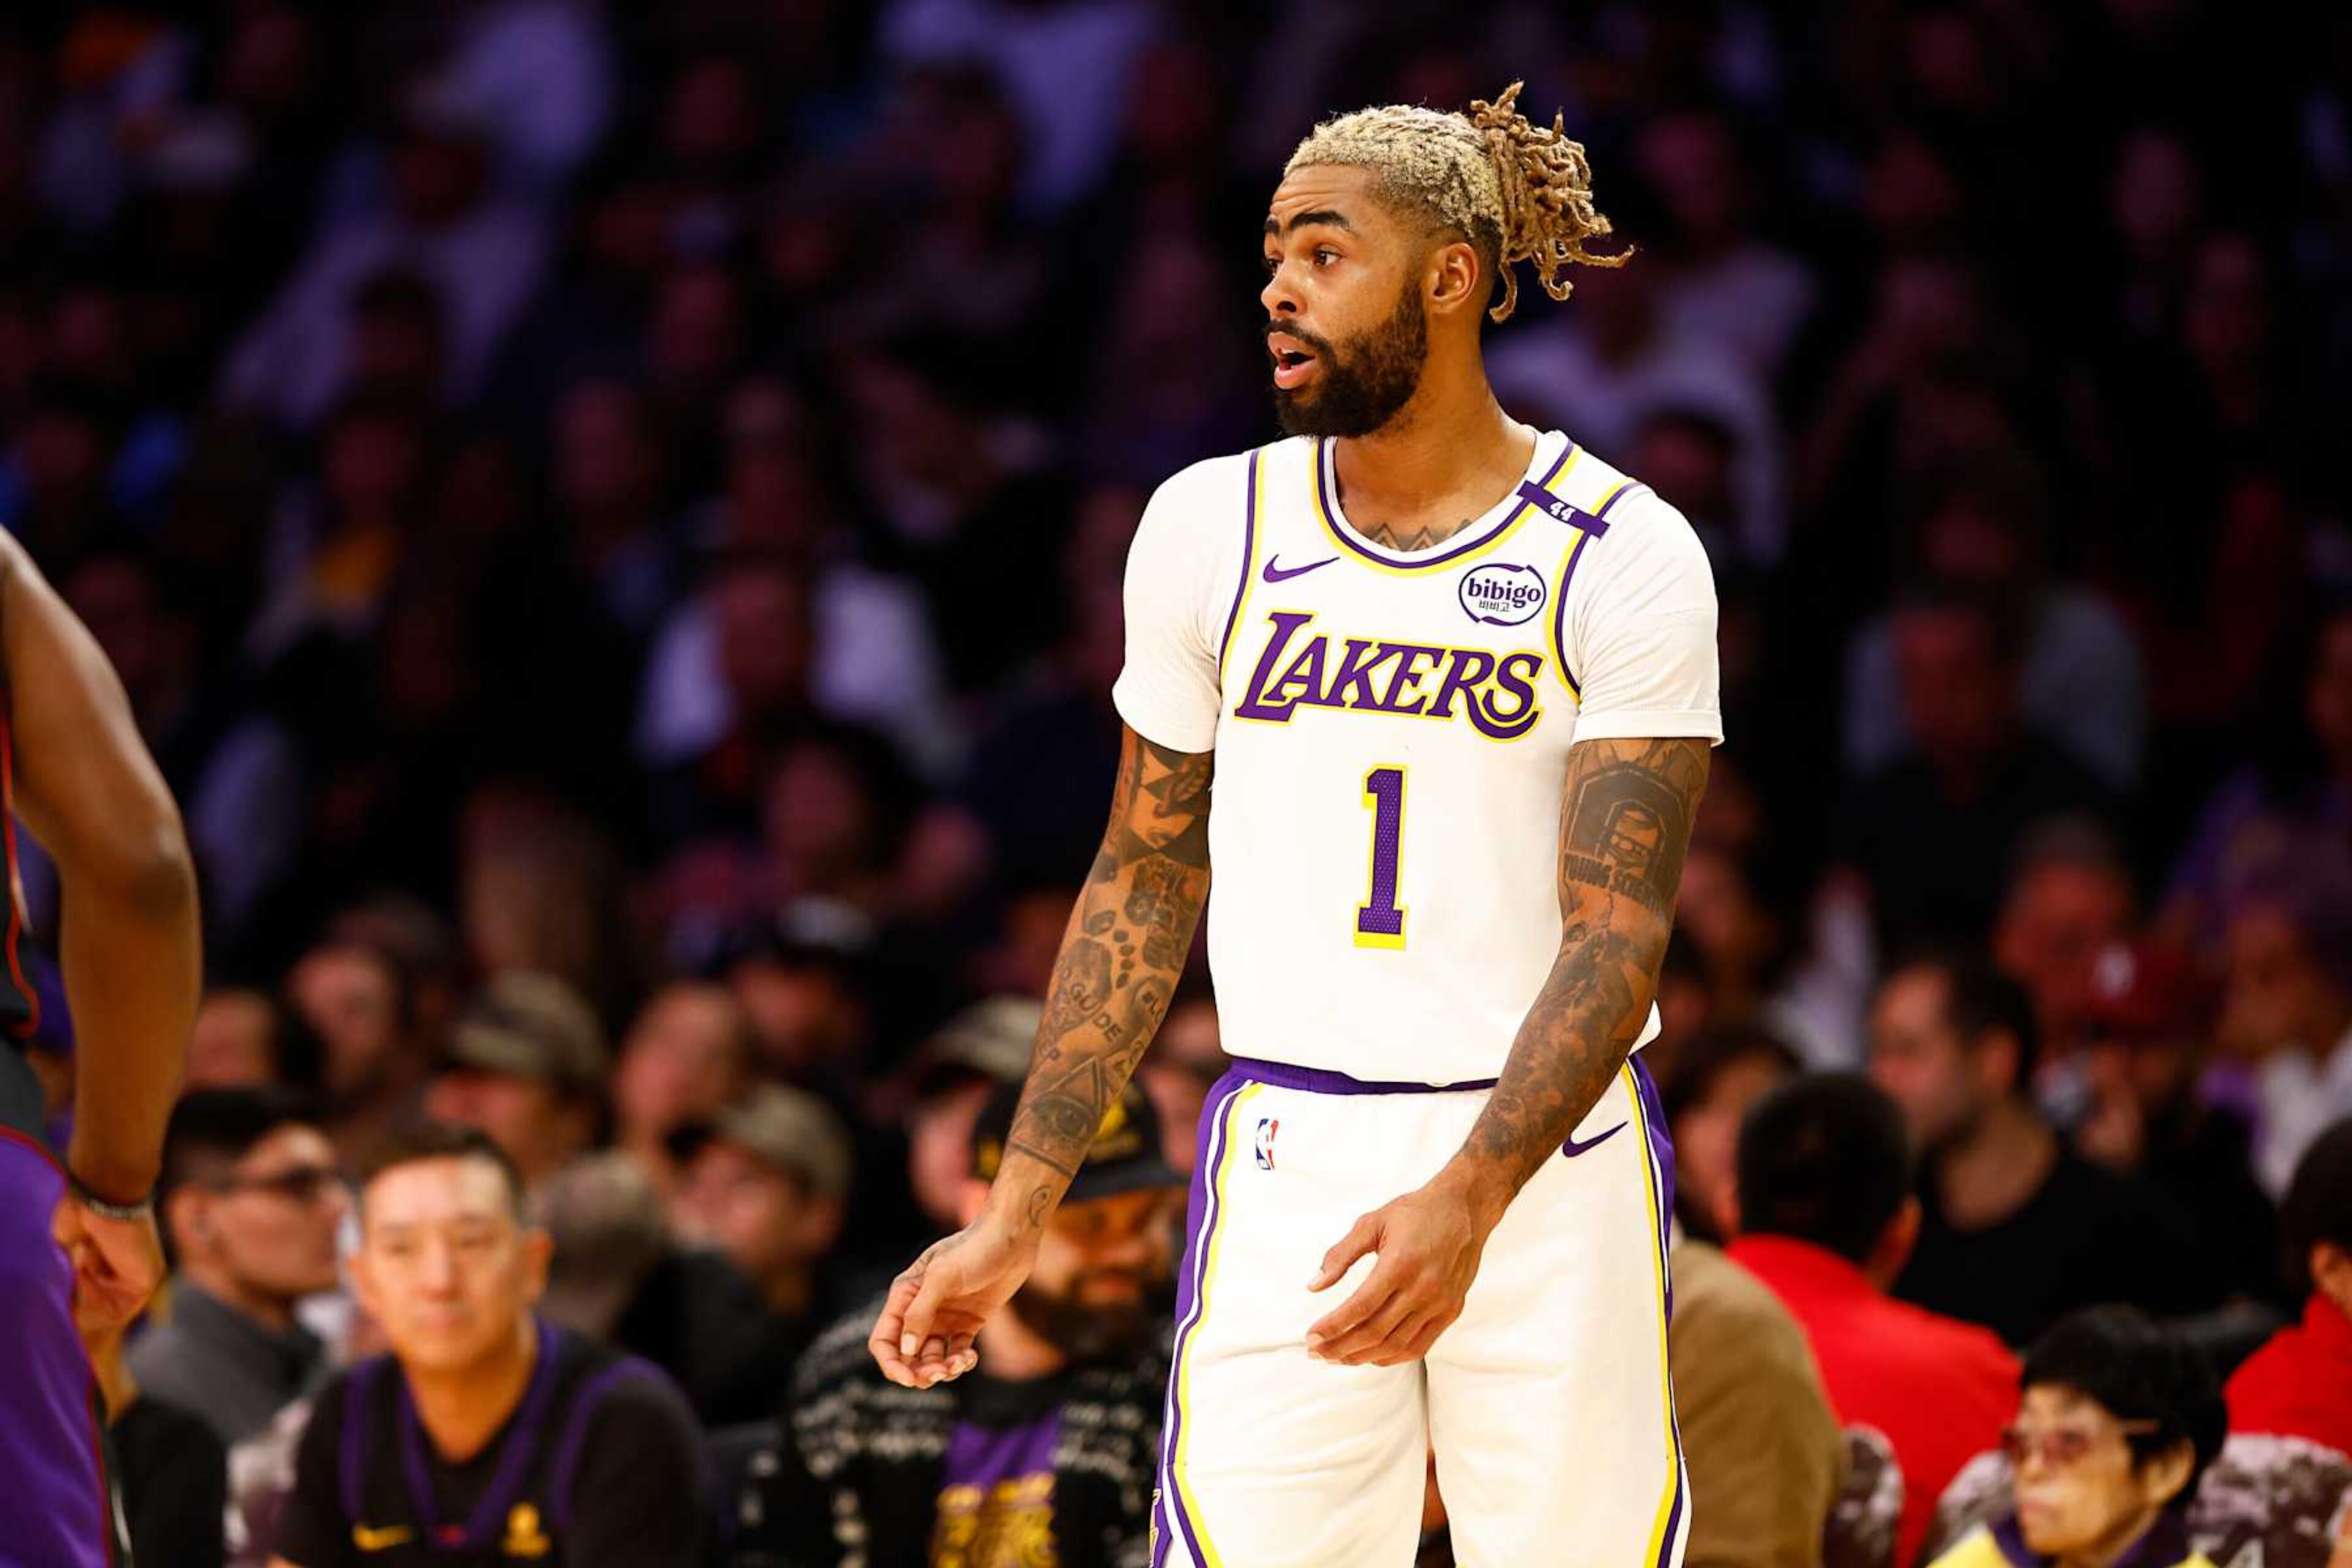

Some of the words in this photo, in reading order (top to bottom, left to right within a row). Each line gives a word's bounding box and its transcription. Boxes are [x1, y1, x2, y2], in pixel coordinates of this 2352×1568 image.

[1549, 501, 1577, 522] 44
[1468, 577, 1541, 608] bibigo
[1479, 600, 1510, 612] 비비고
[1232, 611, 1546, 742] LAKERS
[1354, 764, 1407, 950] 1
[1070, 983, 1122, 1041] GUIDE
